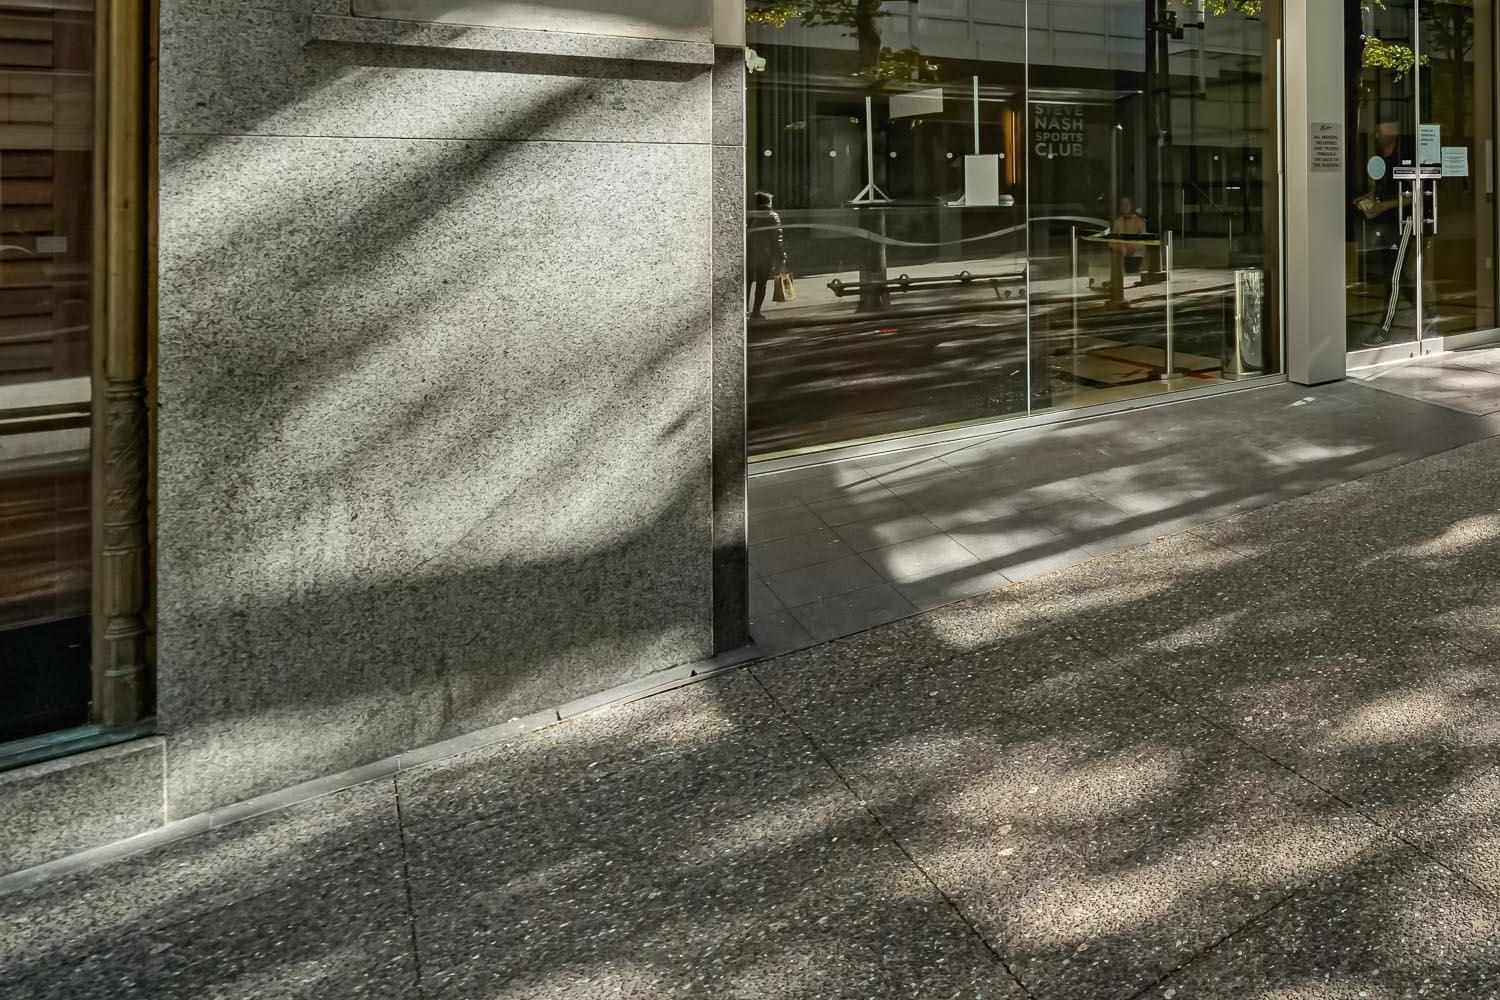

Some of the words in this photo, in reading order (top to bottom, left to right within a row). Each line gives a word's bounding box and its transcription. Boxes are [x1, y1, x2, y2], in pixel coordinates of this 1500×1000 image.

[1034, 104, 1084, 116] STEVE
[1034, 117, 1083, 130] NASH
[1034, 131, 1083, 142] SPORTS
[1034, 143, 1083, 156] CLUB
